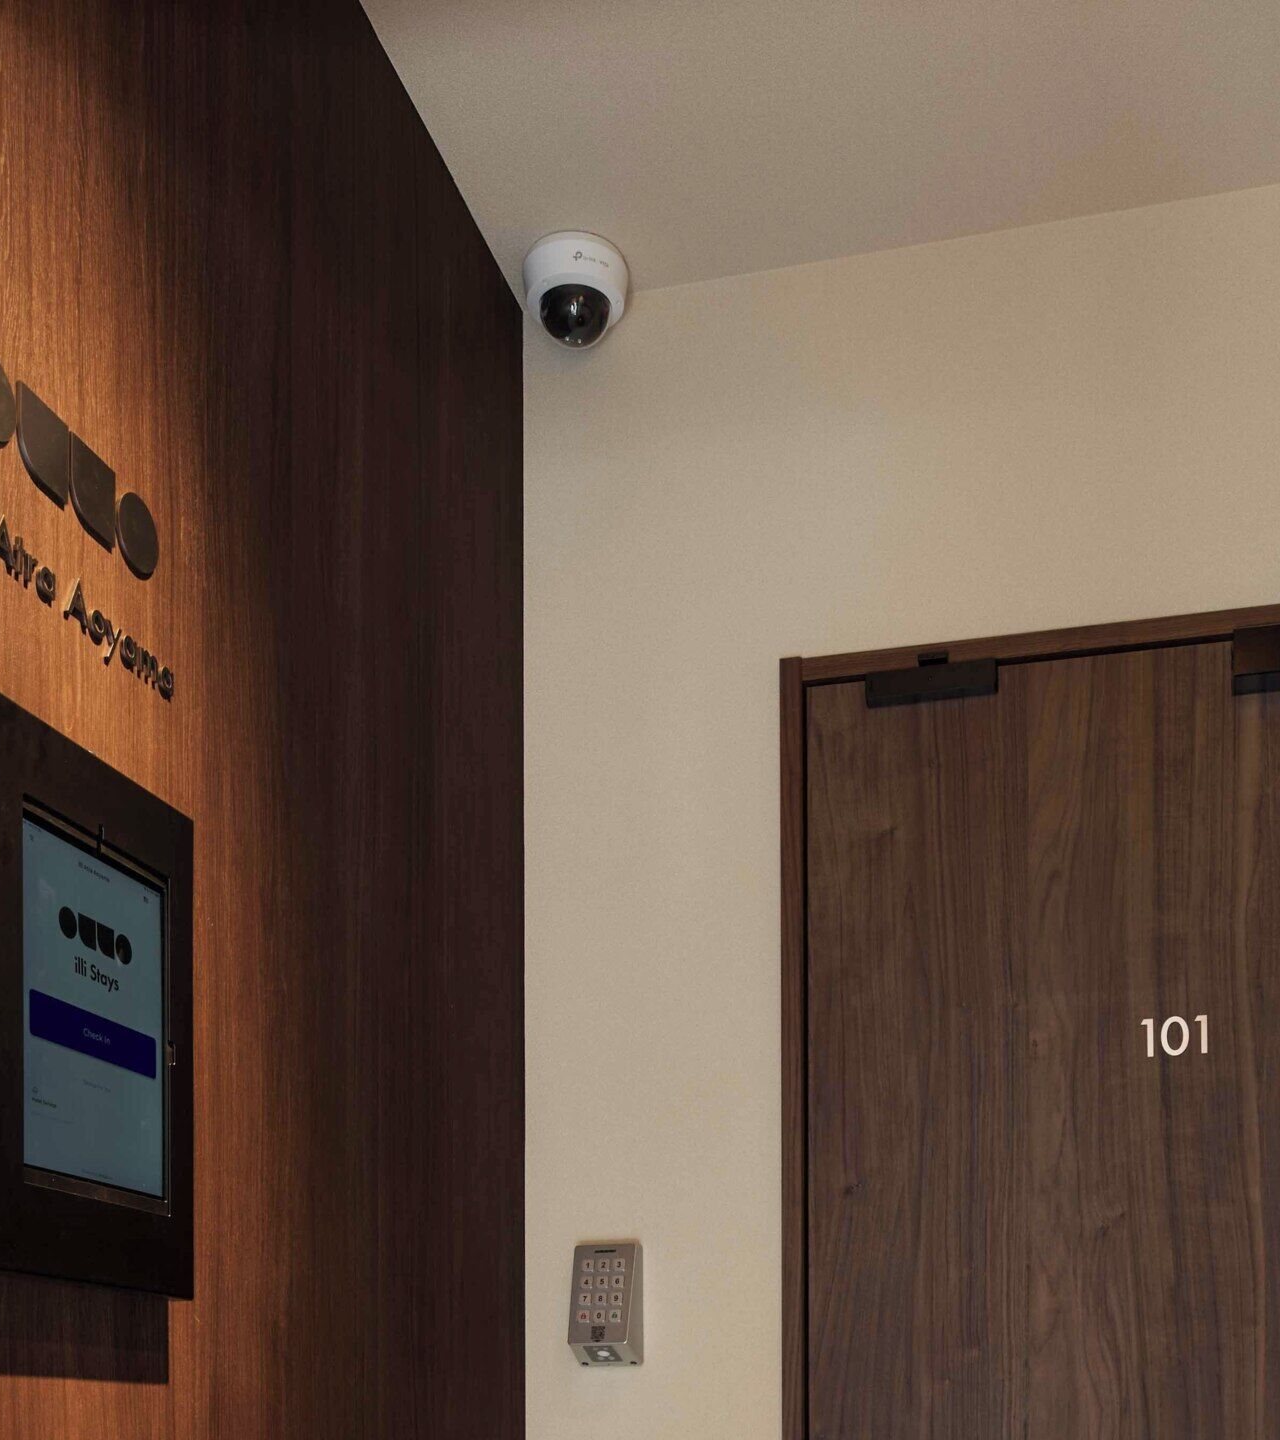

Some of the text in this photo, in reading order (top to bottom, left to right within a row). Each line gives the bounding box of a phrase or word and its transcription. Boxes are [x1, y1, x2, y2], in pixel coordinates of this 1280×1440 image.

[63, 578, 174, 701] Aoyama
[74, 956, 120, 992] illi Stays
[1140, 1014, 1208, 1058] 101
